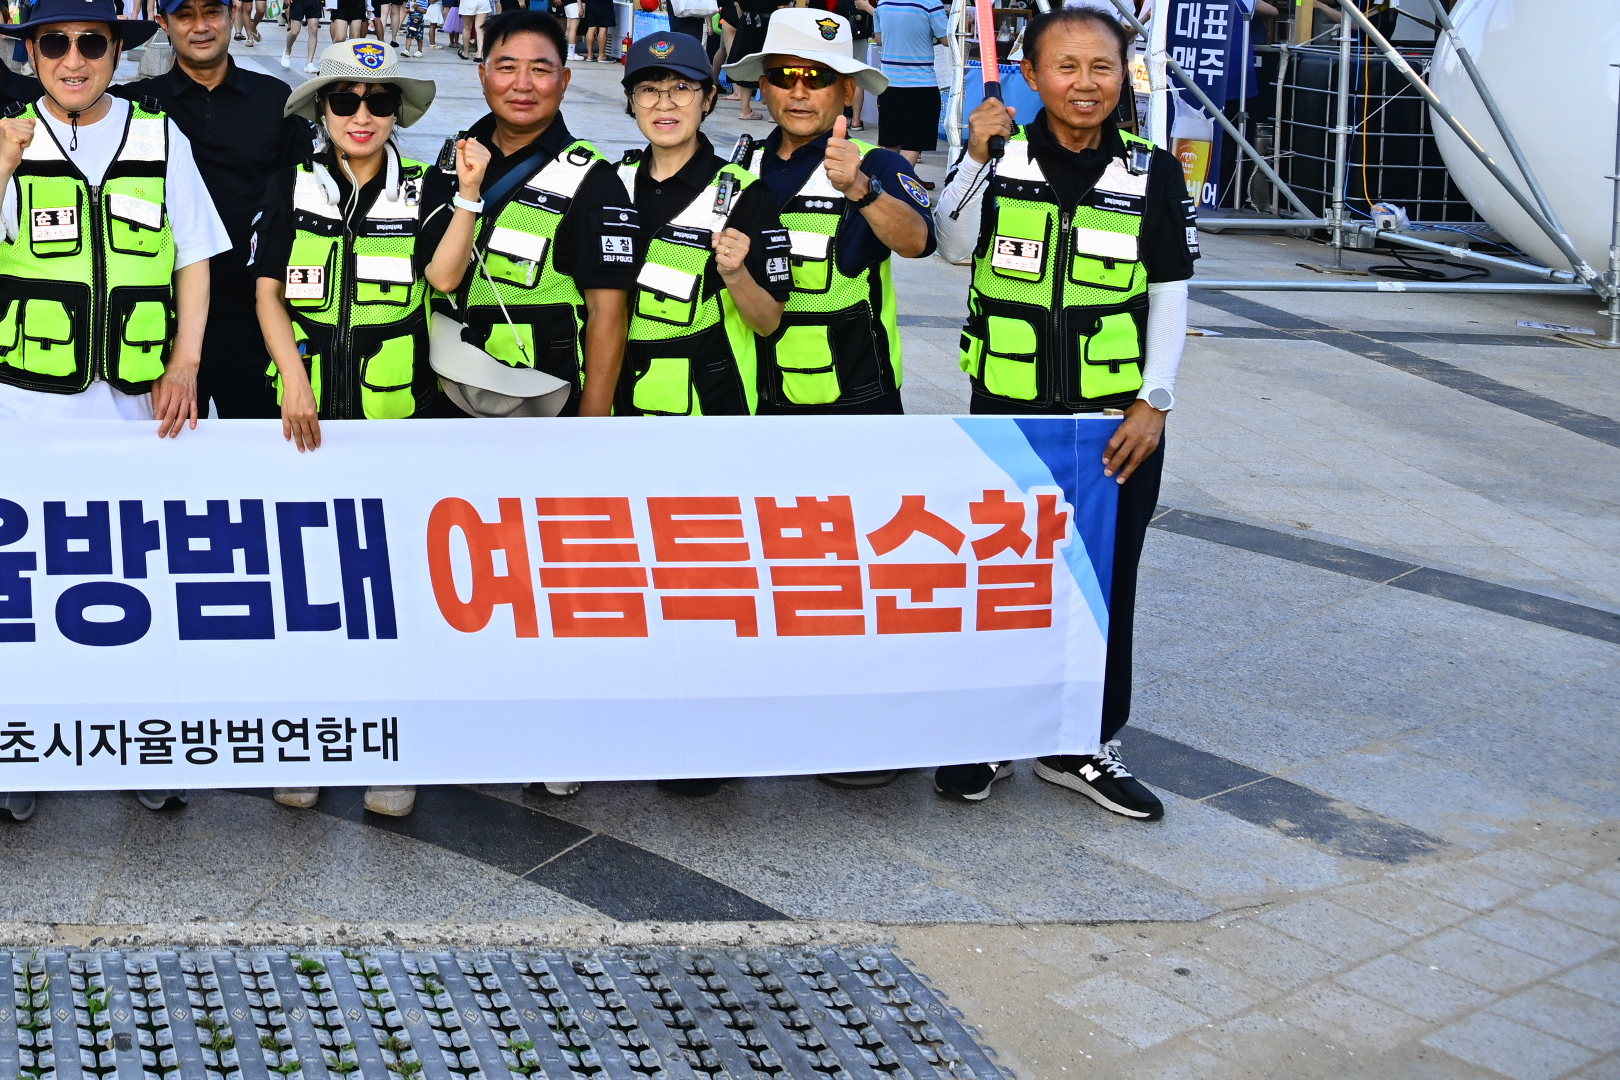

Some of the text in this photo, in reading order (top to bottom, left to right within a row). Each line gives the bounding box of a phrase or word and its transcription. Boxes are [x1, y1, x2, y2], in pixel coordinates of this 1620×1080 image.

[1175, 2, 1230, 41] 대표
[35, 209, 74, 226] 순찰
[603, 238, 632, 254] 순찰
[998, 240, 1039, 259] 순찰
[603, 254, 634, 264] SELF POLICE
[768, 257, 789, 273] 순찰
[289, 268, 321, 284] 순찰
[427, 487, 1068, 640] 여름특별순찰
